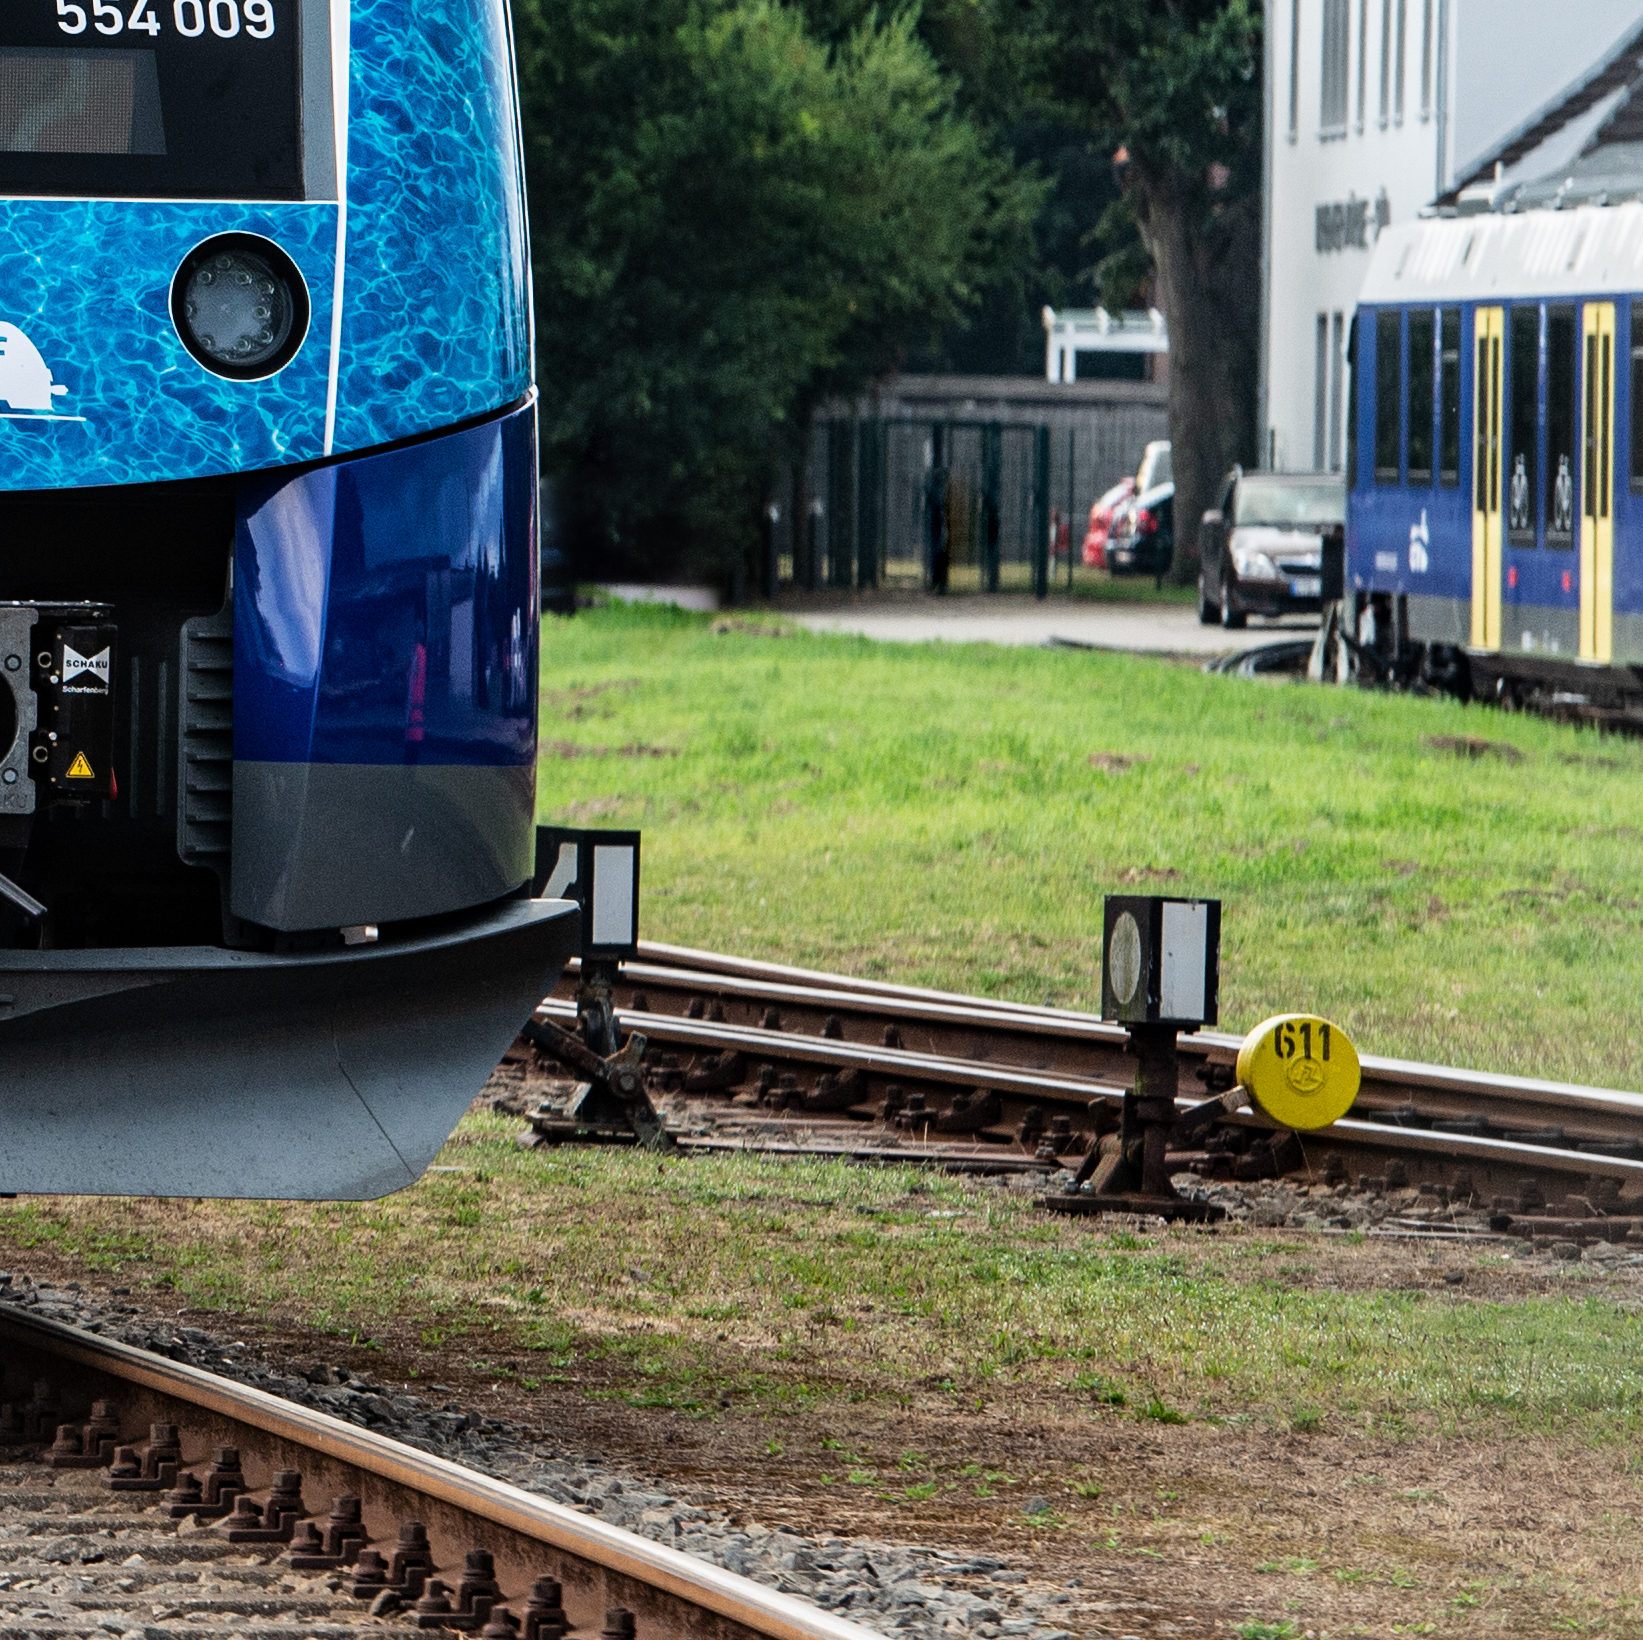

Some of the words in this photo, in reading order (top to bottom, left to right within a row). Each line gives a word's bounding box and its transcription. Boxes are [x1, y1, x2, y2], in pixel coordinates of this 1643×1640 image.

[65, 659, 108, 669] SCHAKU
[62, 685, 109, 696] Scharfenberg
[1274, 1021, 1331, 1061] 611
